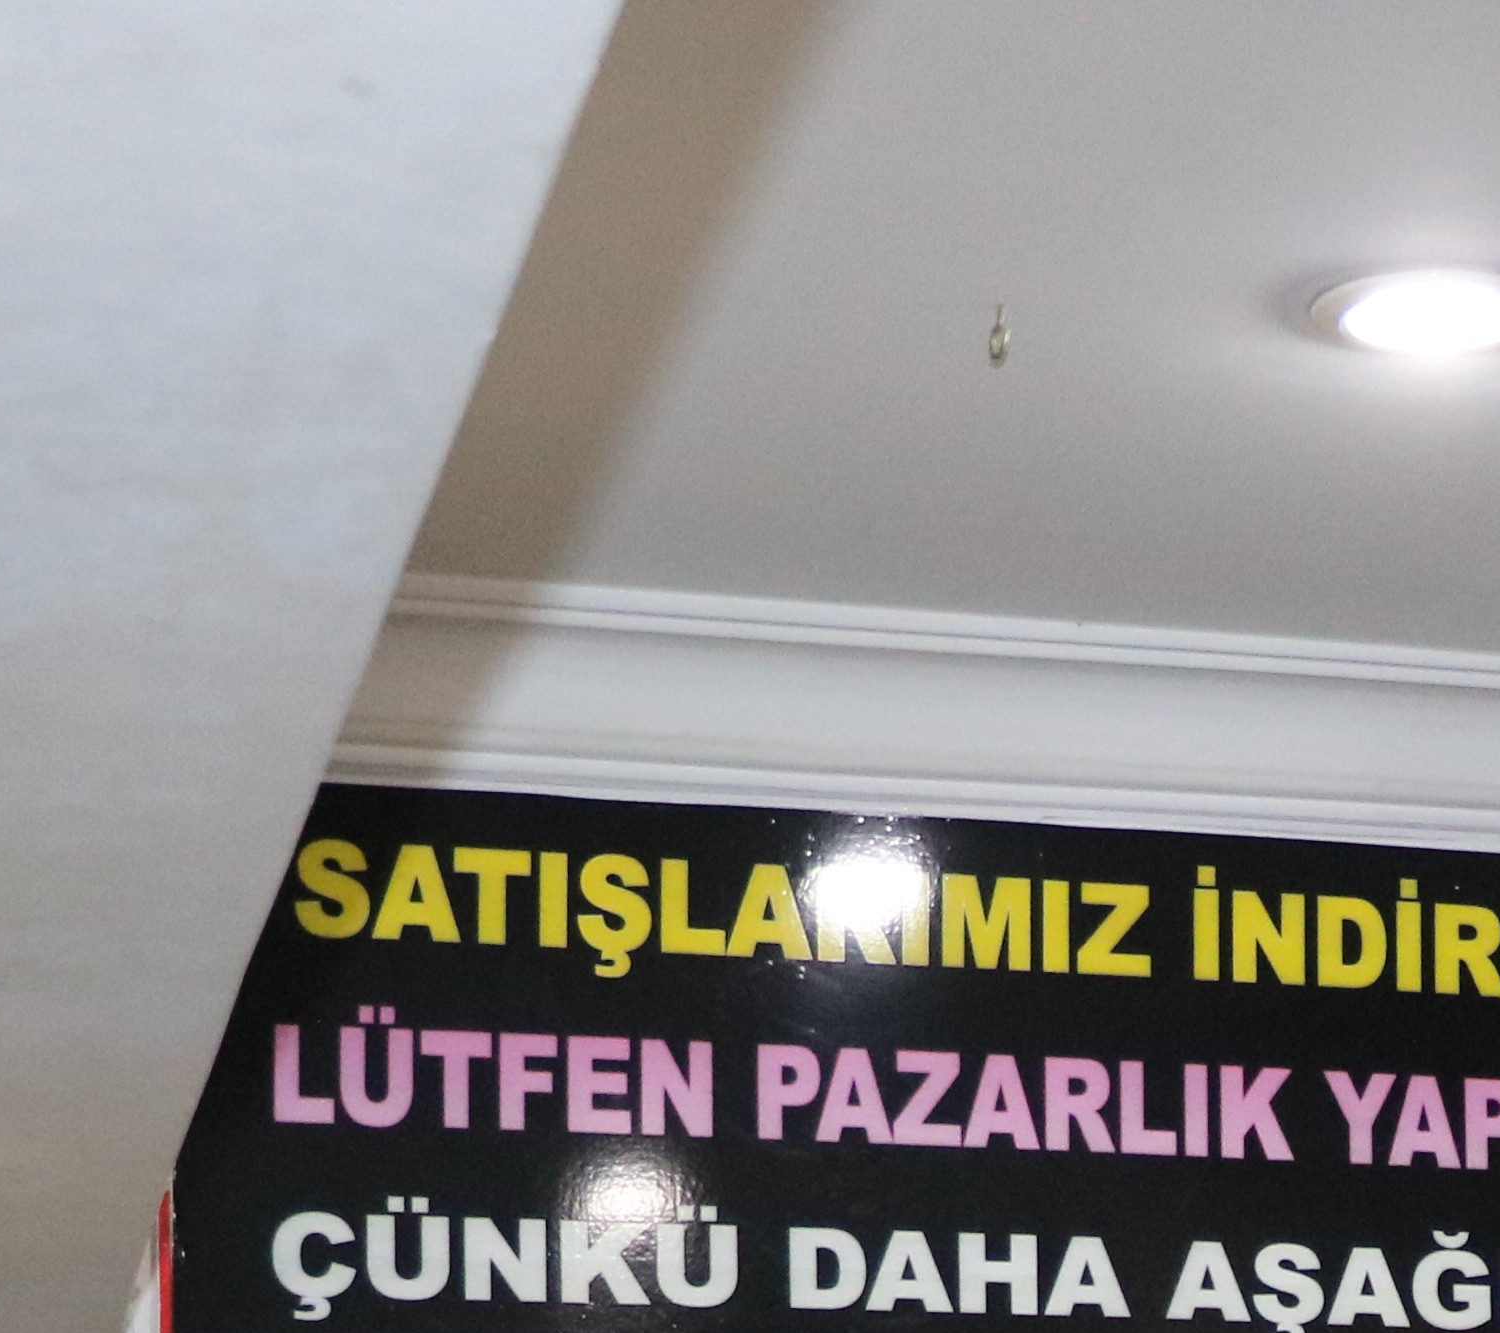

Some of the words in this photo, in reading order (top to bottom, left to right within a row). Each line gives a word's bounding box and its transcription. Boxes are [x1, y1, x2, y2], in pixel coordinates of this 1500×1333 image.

[296, 841, 1151, 977] SATIŞLARIMIZ
[272, 1006, 714, 1138] LÜTFEN
[757, 1042, 1294, 1162] PAZARLIK
[271, 1194, 740, 1321] ÇÜNKÜ
[789, 1226, 1130, 1318] DAHA
